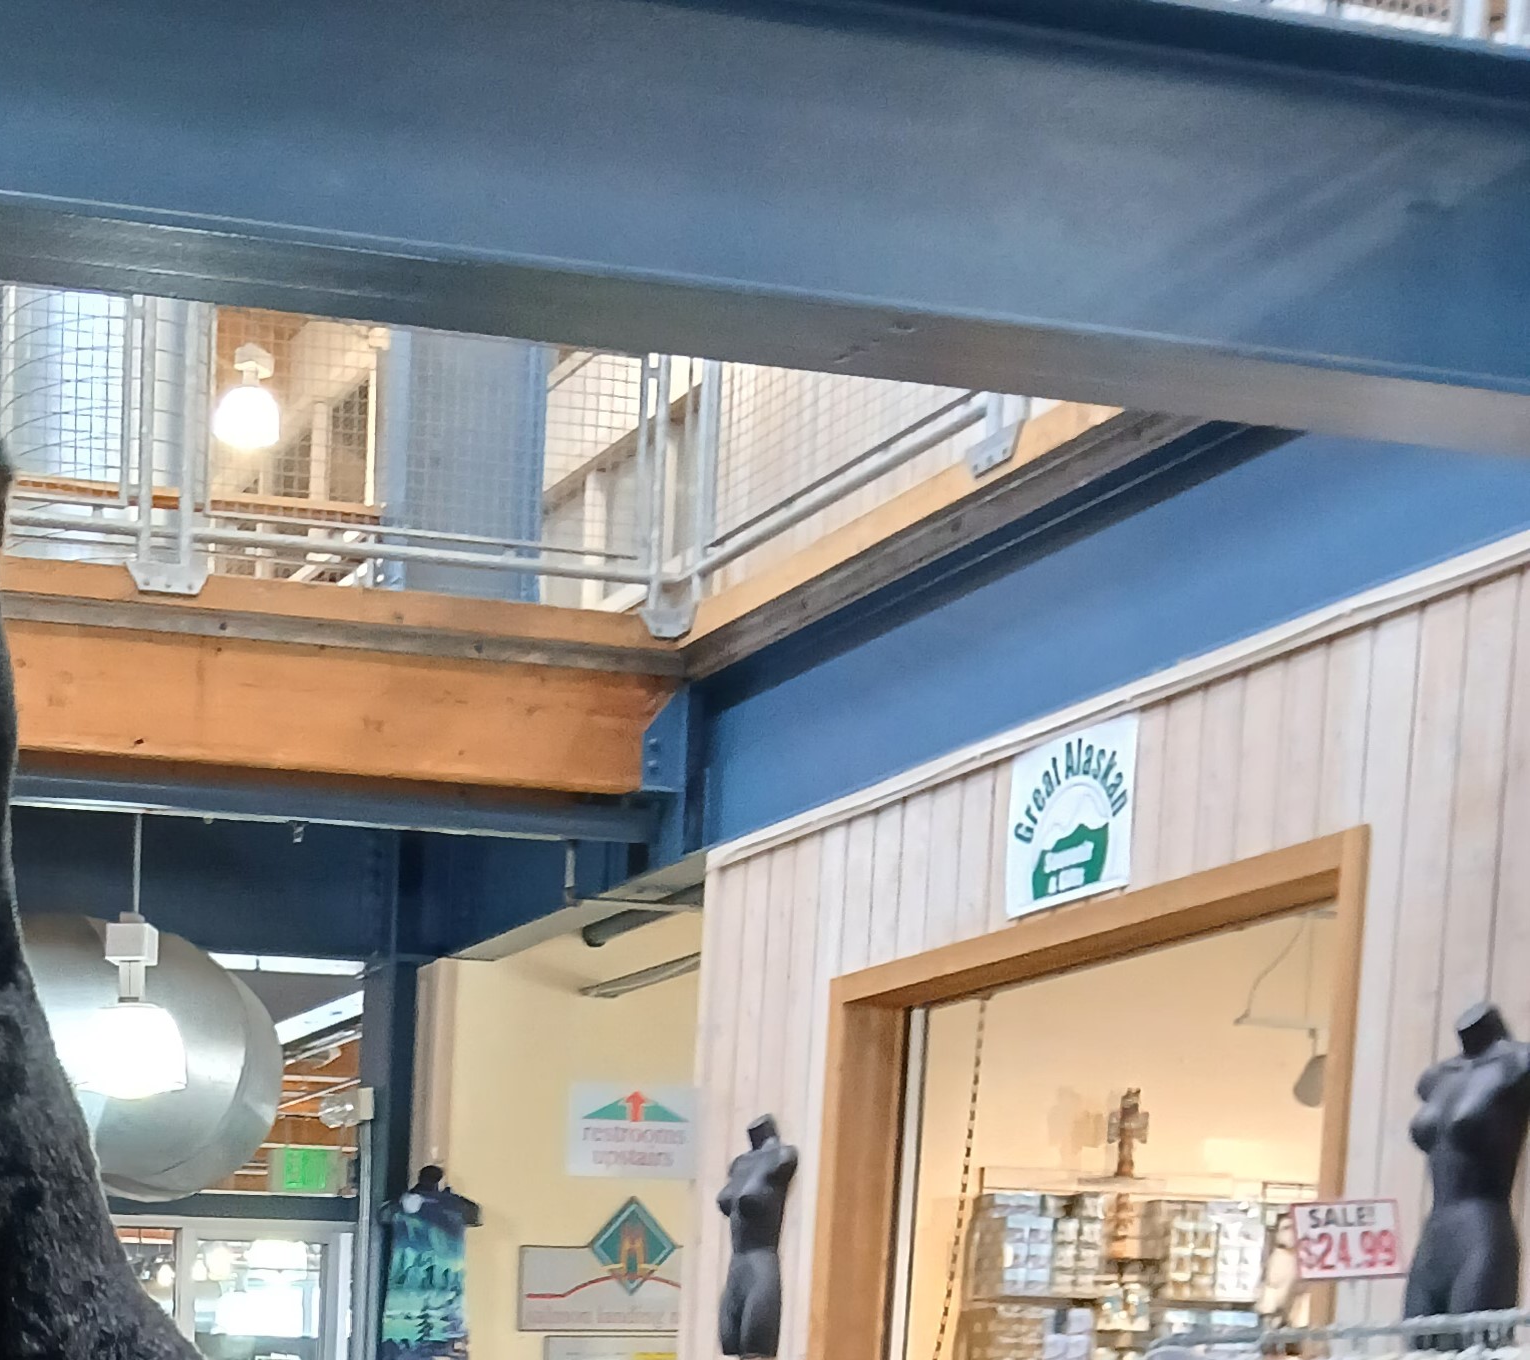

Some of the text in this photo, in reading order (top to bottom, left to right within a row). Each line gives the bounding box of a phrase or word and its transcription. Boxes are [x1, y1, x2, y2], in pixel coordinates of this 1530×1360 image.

[1013, 738, 1128, 844] Great Alaskan
[582, 1126, 687, 1145] restrooms
[1298, 1229, 1397, 1270] $24.99
